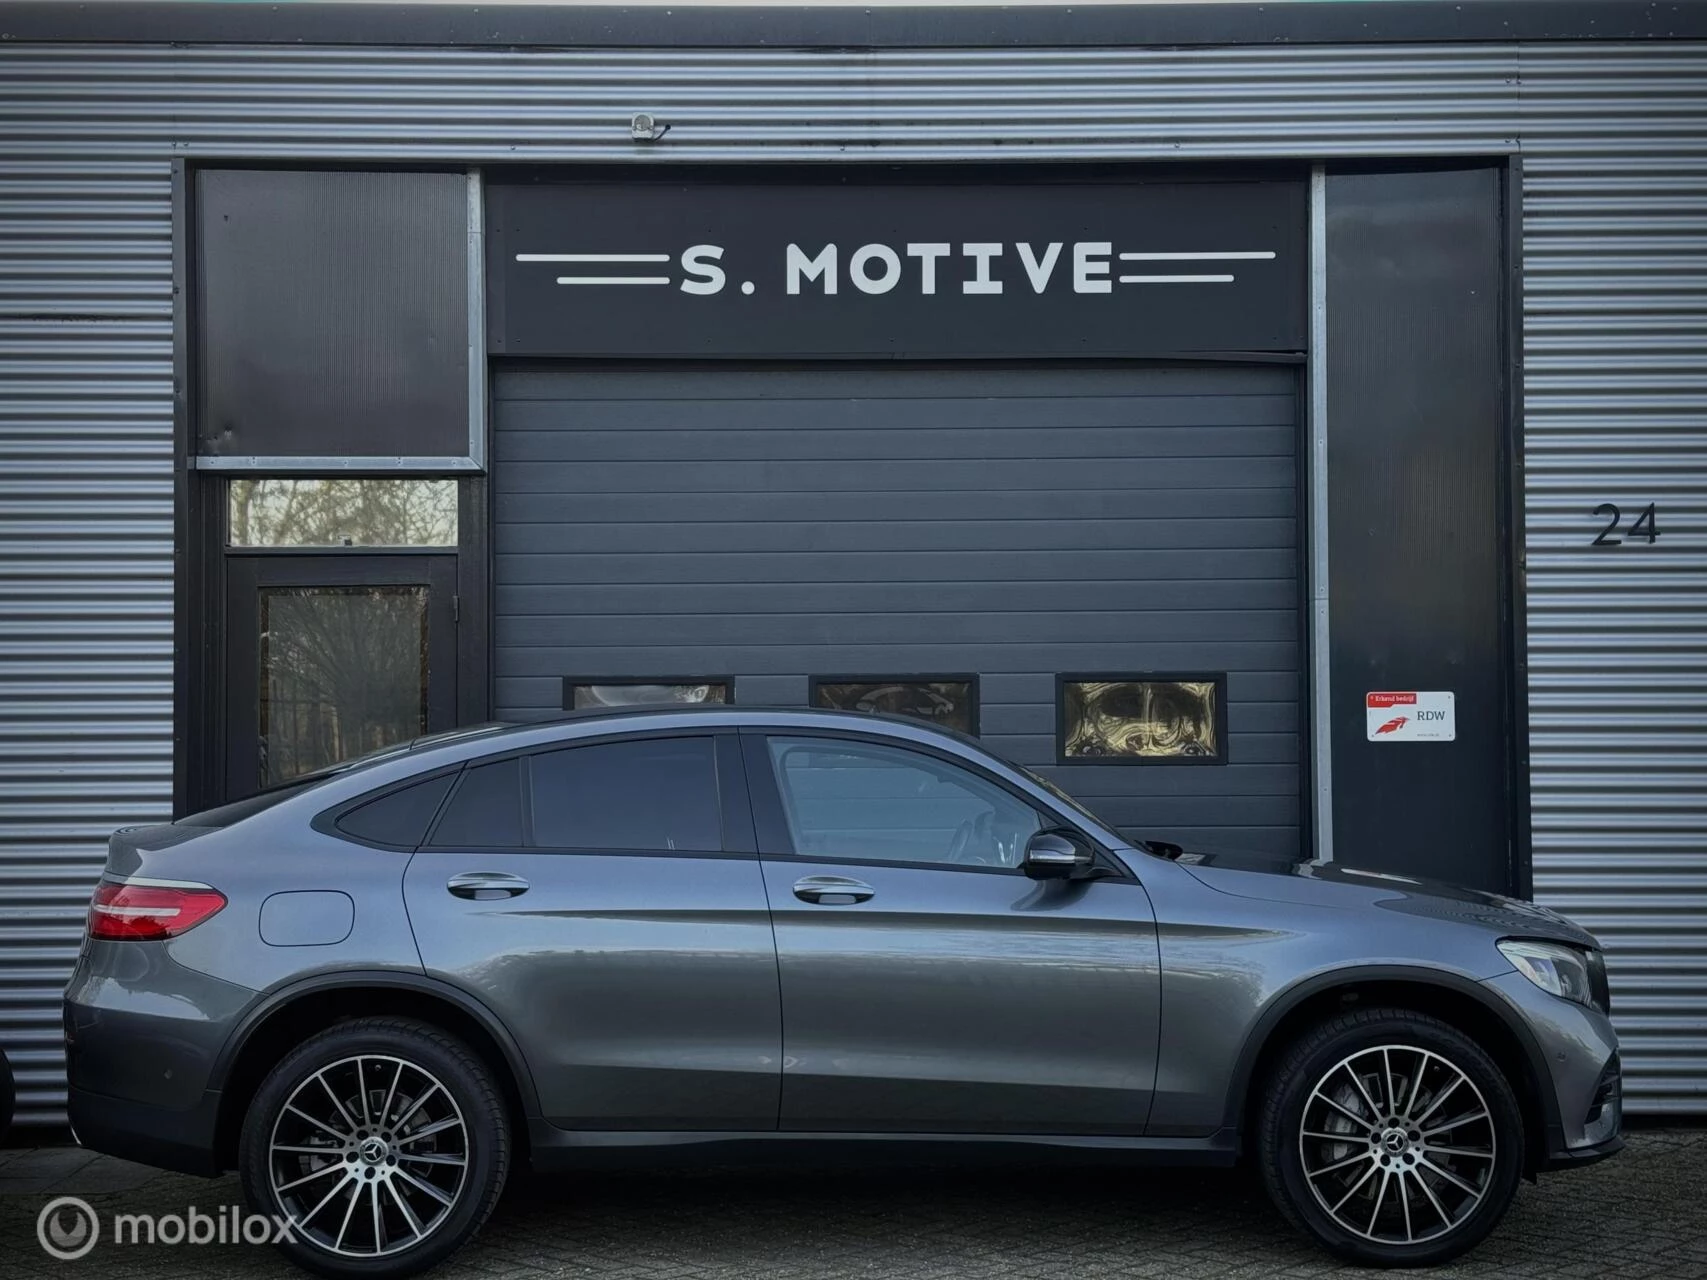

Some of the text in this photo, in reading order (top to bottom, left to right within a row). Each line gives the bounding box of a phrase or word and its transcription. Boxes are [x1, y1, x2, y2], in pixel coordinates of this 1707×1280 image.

[680, 242, 1112, 295] S. MOTIVE
[1591, 502, 1661, 545] 24
[1417, 710, 1445, 721] RDW
